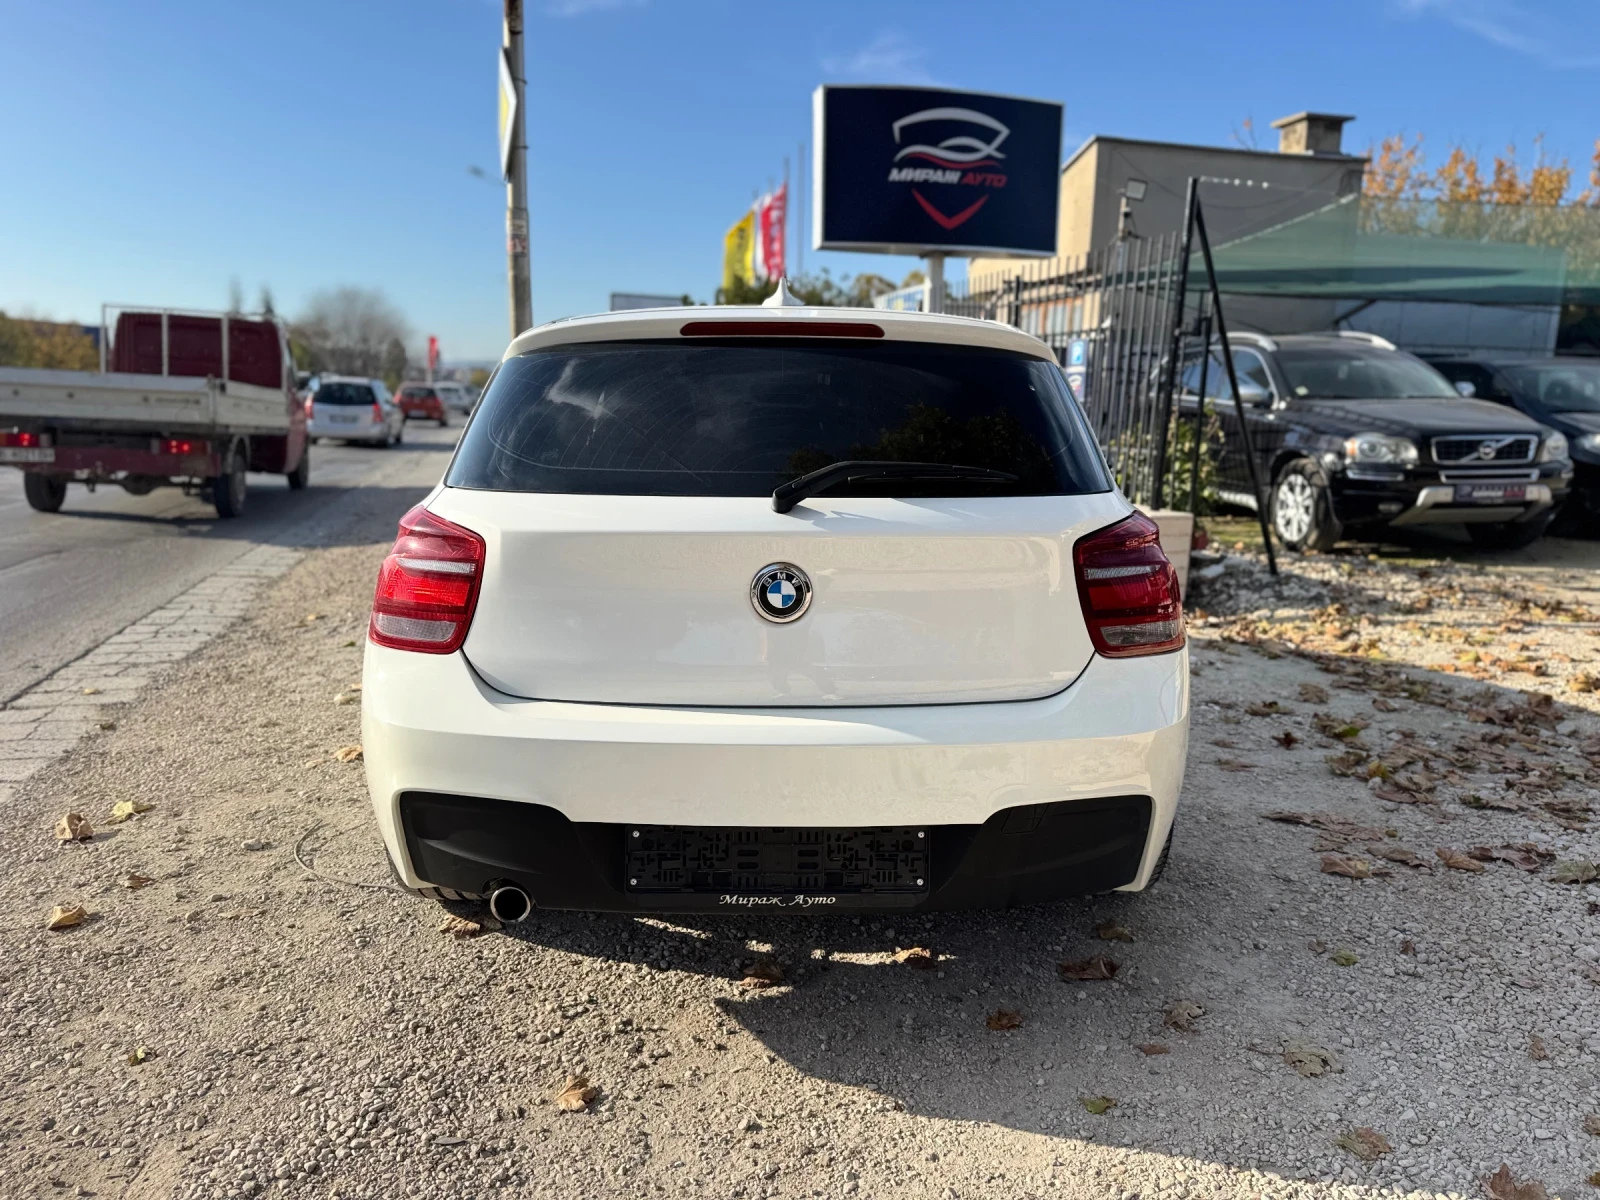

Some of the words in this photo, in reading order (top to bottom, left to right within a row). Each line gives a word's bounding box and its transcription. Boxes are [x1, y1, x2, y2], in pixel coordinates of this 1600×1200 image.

[888, 167, 962, 185] МИРАЖ
[962, 172, 1007, 188] АУТО
[763, 571, 801, 588] BMW
[719, 894, 786, 907] Мираж
[789, 894, 836, 907] Ауто
